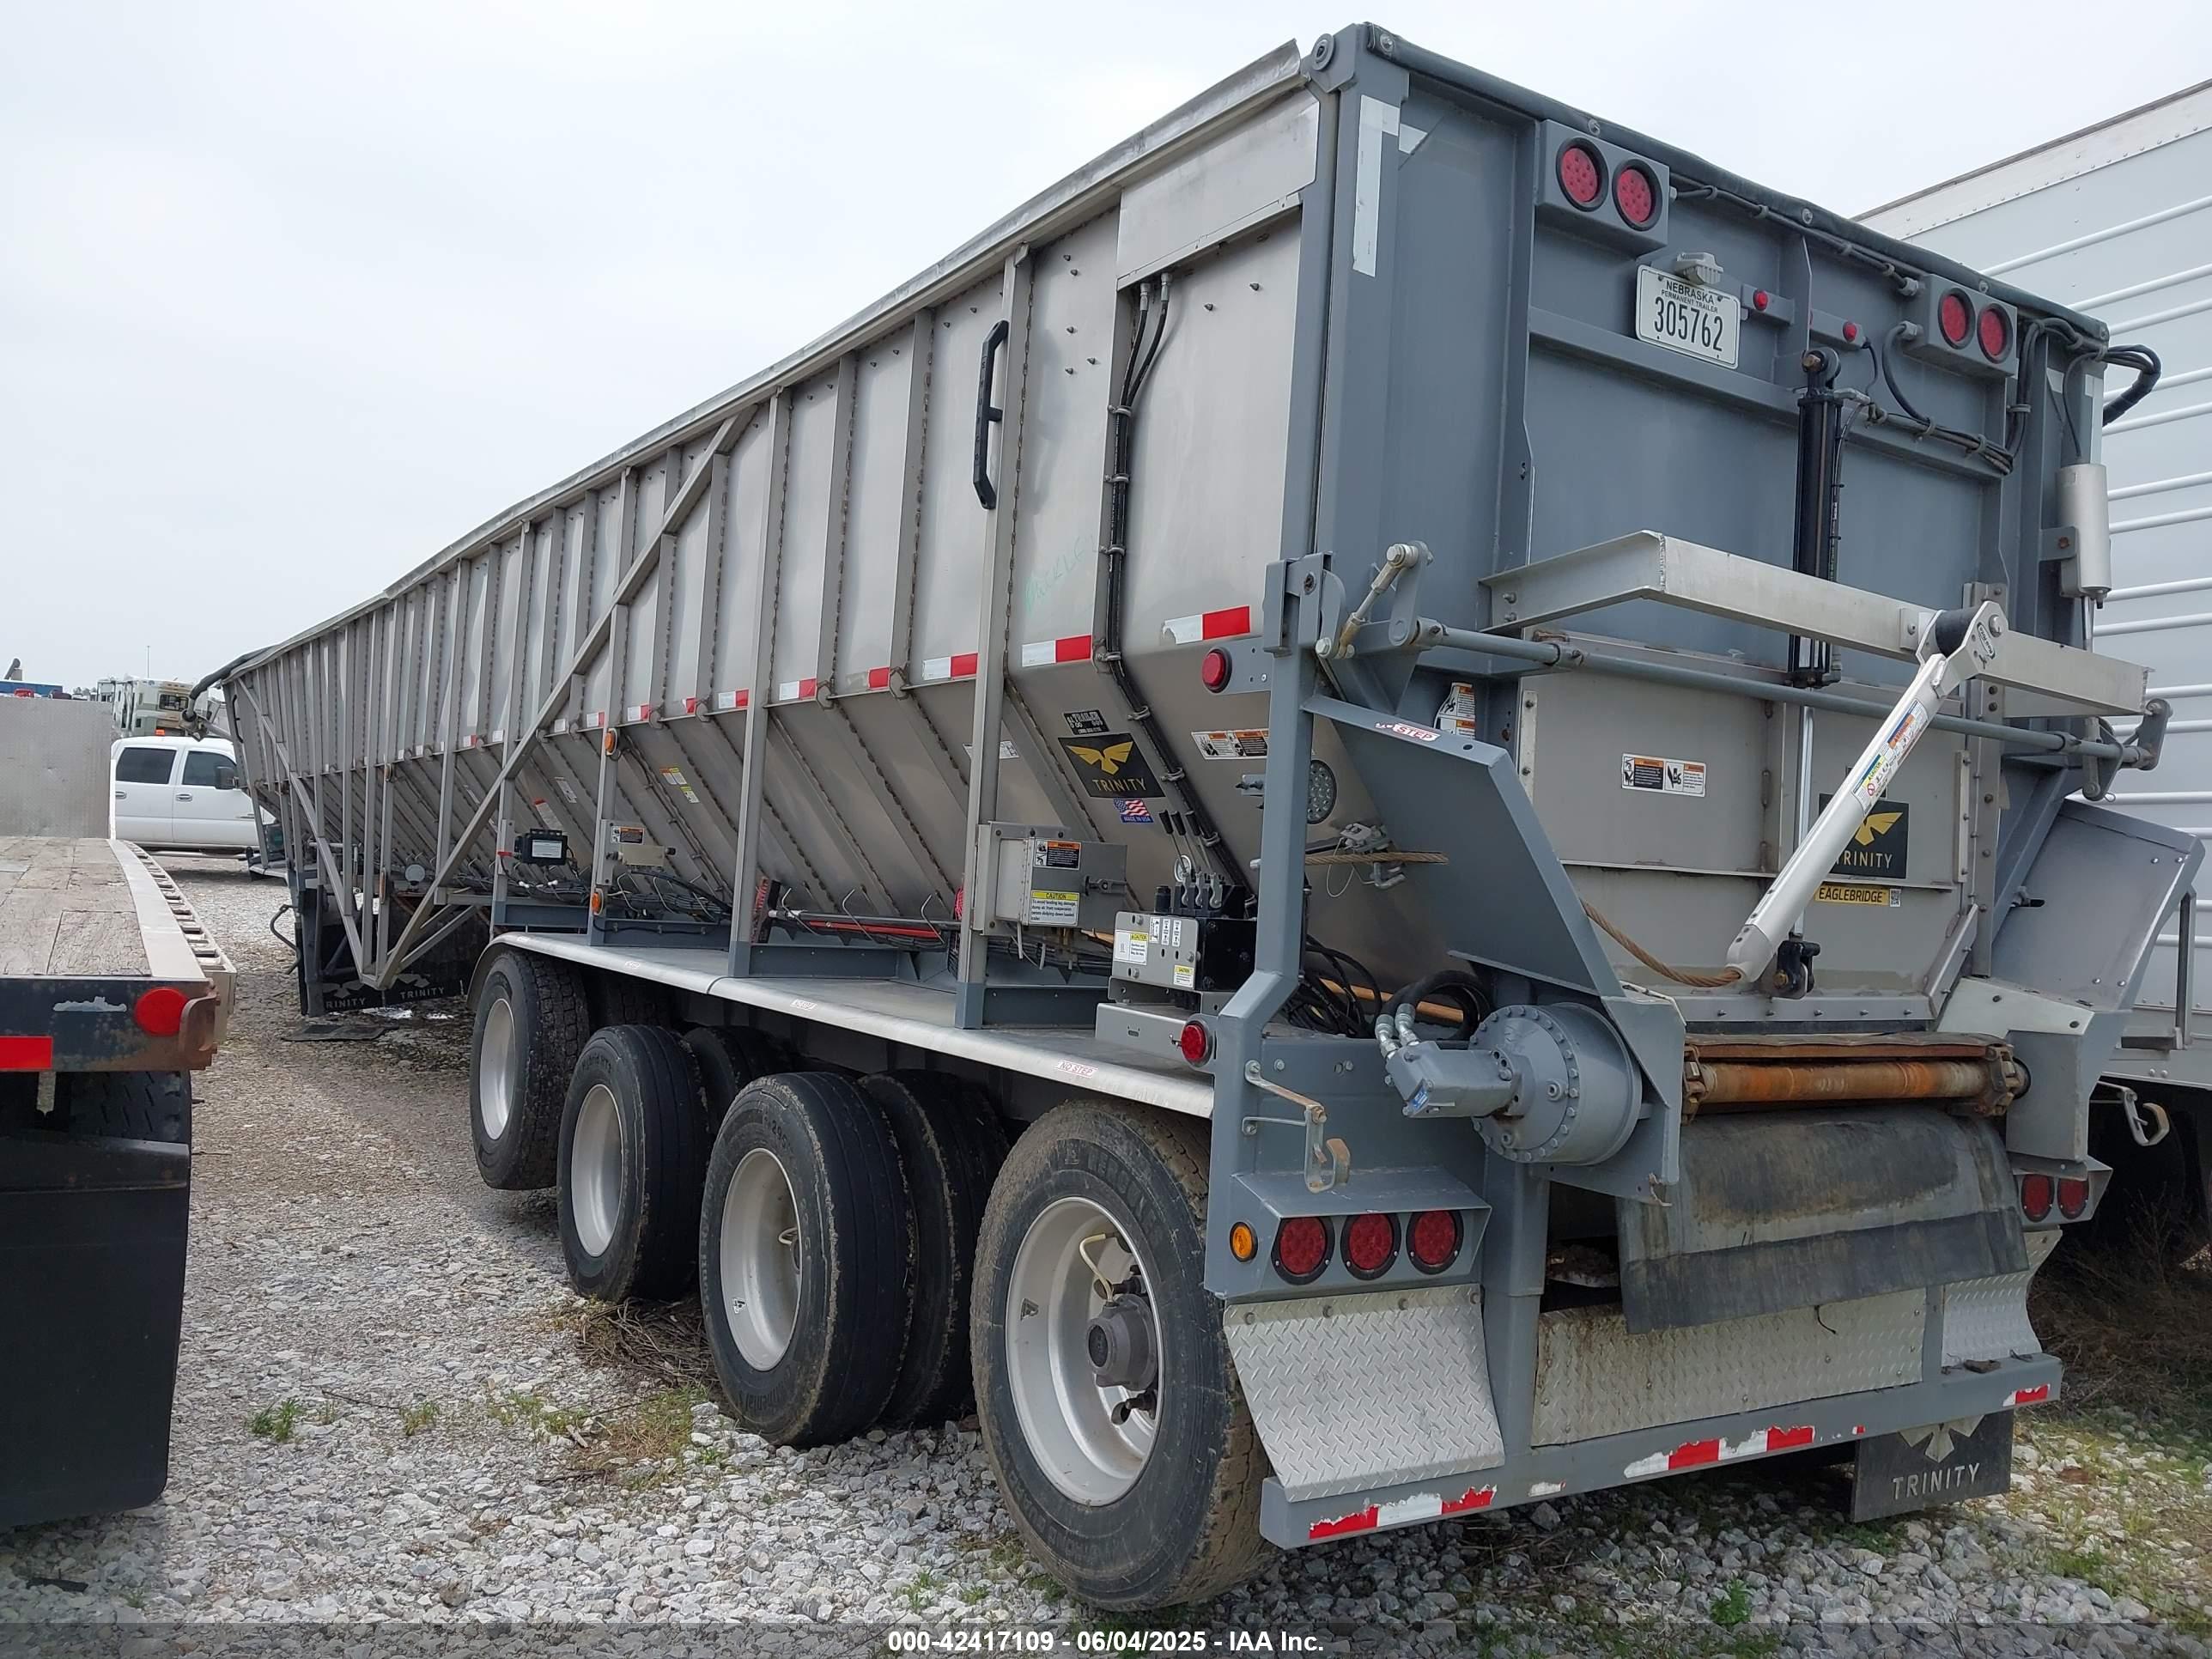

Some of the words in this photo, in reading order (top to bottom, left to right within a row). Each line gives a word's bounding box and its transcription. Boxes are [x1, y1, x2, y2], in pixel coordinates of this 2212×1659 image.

[1661, 289, 1695, 306] PERMANENT
[1696, 301, 1718, 313] TRAILER
[1666, 281, 1714, 305] NEBRASKA
[1654, 296, 1723, 352] 305762
[1398, 726, 1432, 740] STEP
[1091, 777, 1147, 792] TRINITY
[1836, 849, 1893, 869] RINITY
[1819, 886, 1883, 903] EAGLEBRIDGE
[400, 987, 445, 1000] TRINITY
[325, 997, 366, 1009] RINITY
[1060, 1062, 1073, 1071] NO
[1072, 1065, 1093, 1074] STEP
[1893, 1462, 1980, 1500] TRINITY
